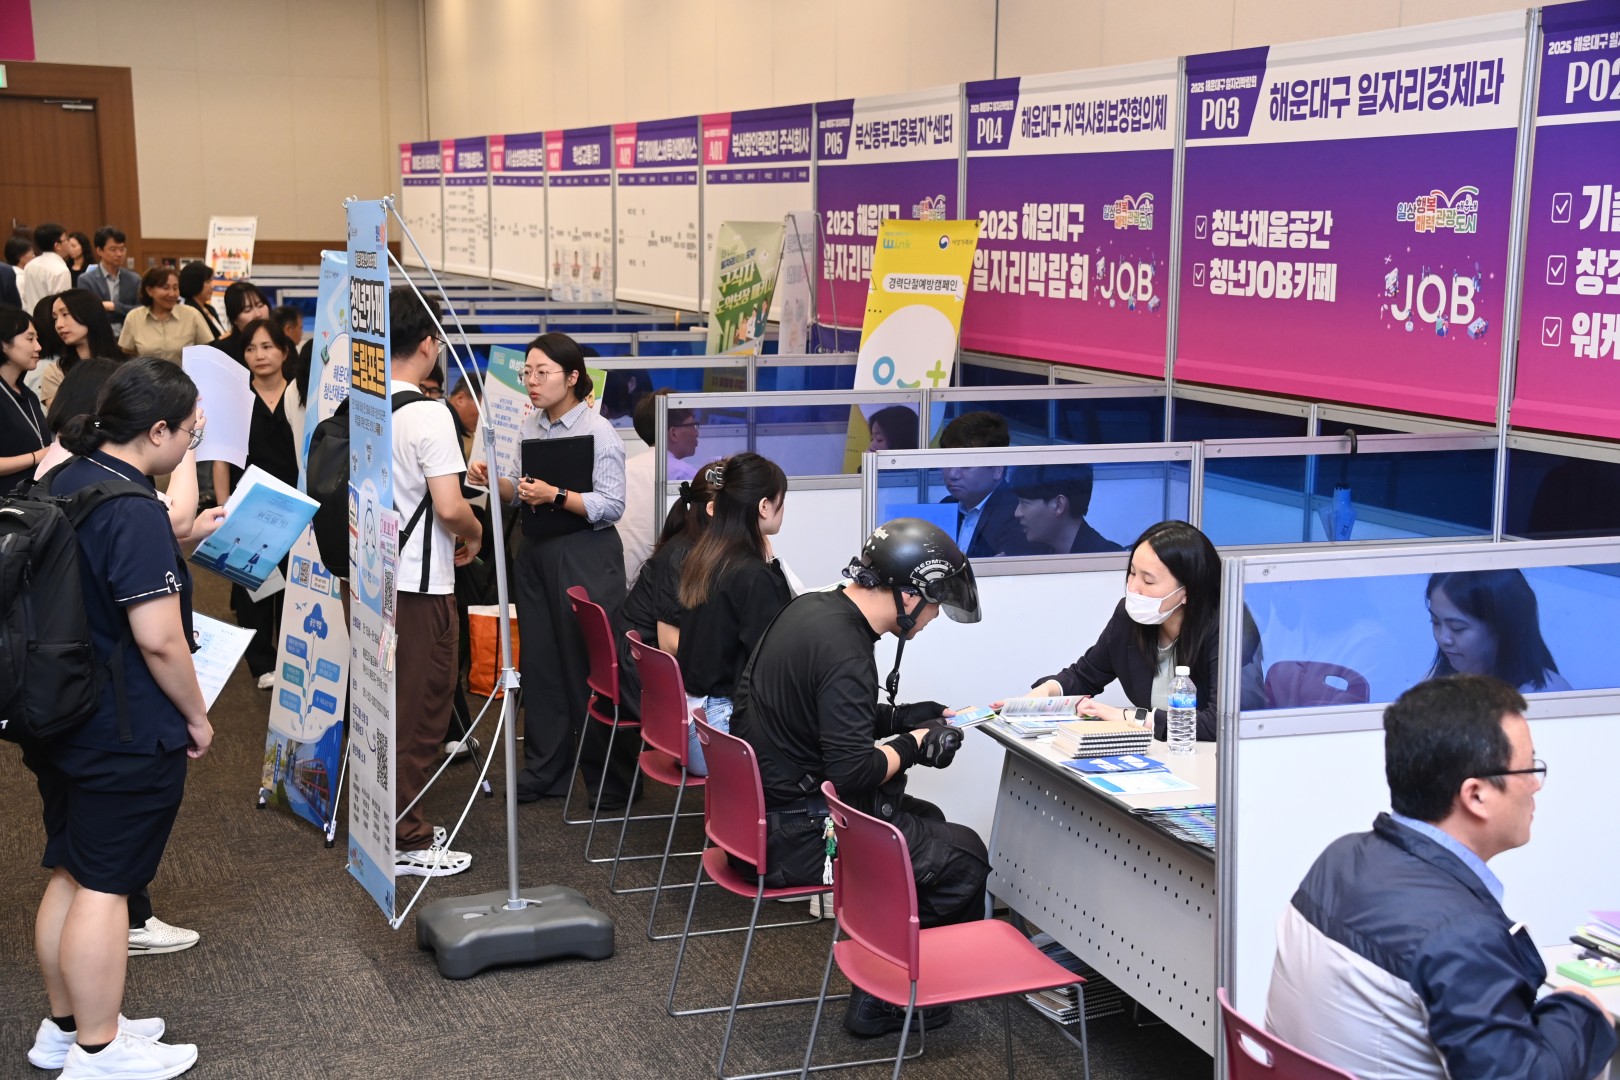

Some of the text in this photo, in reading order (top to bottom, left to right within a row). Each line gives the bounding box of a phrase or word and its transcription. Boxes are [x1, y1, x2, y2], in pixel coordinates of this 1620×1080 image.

[1548, 40, 1572, 55] 2025
[1574, 32, 1608, 52] 해운대구
[1190, 82, 1204, 94] 2025
[1205, 77, 1224, 92] 해운대구
[1270, 58, 1504, 122] 해운대구 일자리경제과
[977, 117, 1004, 144] P04
[1022, 94, 1168, 138] 해운대구 지역사회보장협의체
[1201, 97, 1240, 130] P03
[780, 126, 810, 155] 주식회사
[824, 131, 844, 156] P05
[826, 210, 854, 236] 2025
[979, 203, 1084, 243] 2025 해운대구
[1211, 210, 1334, 250] 청년채움공간
[720, 260, 756, 292] 구직자
[888, 277, 958, 292] 경력단절예방캠페인
[973, 250, 1089, 302] 일자리박람회
[1100, 261, 1153, 302] JOB
[1210, 258, 1338, 302] 청년JOB카페
[350, 277, 385, 337] 청년카페
[716, 286, 751, 312] 도약보장
[1390, 275, 1476, 325] JOB
[352, 338, 386, 398] 드림포트
